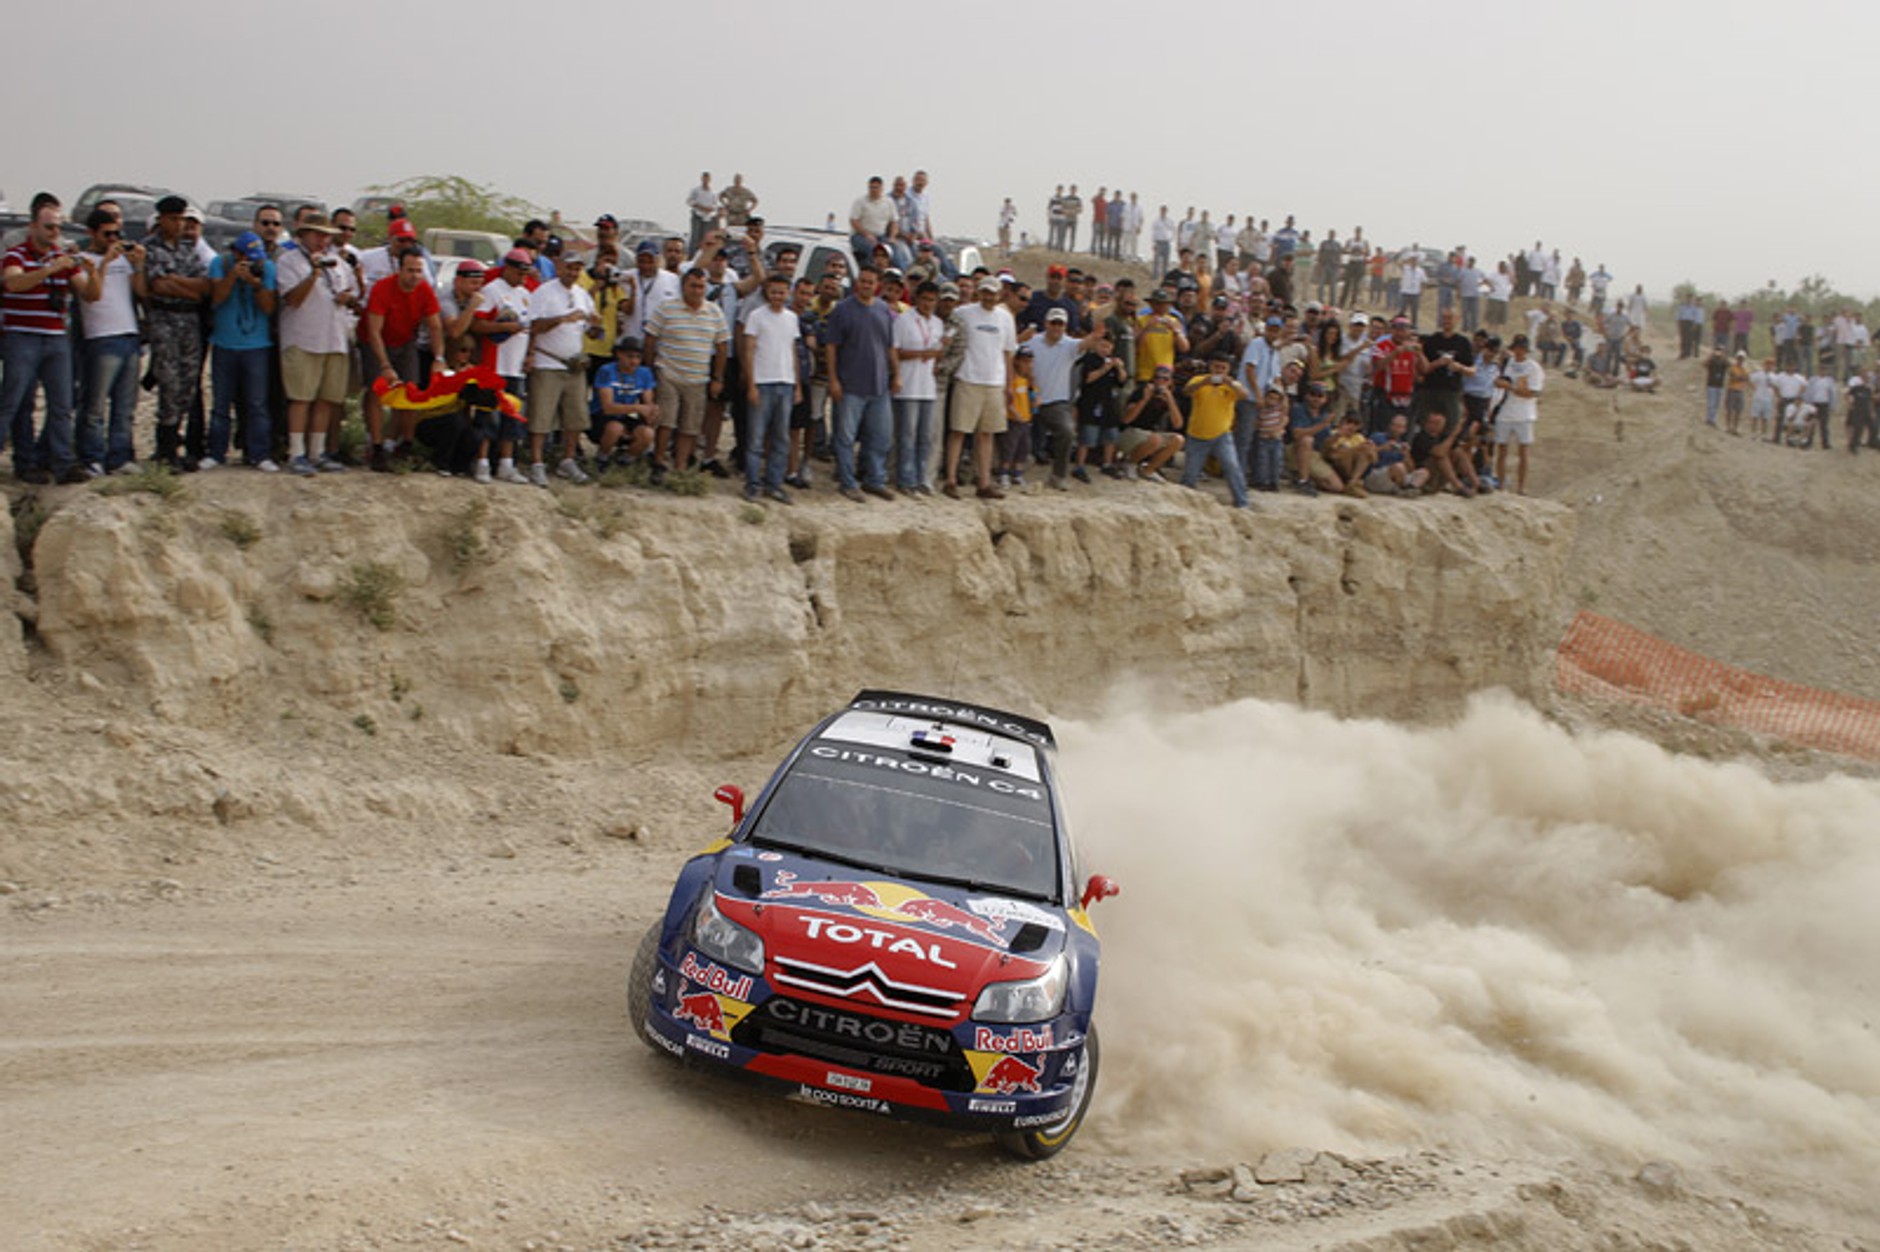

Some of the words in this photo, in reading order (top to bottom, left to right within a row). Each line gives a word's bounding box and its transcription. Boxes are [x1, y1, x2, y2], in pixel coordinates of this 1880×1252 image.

[851, 700, 998, 726] CITROËN
[1002, 722, 1049, 745] C4
[811, 746, 980, 786] CITROËN
[987, 779, 1042, 800] C4
[799, 915, 957, 969] TOTAL
[680, 951, 714, 983] Red
[707, 968, 753, 1002] Bull
[768, 999, 951, 1053] CITROËN
[975, 1025, 1020, 1053] Red
[1021, 1023, 1054, 1053] Bull
[874, 1054, 946, 1078] SPORT
